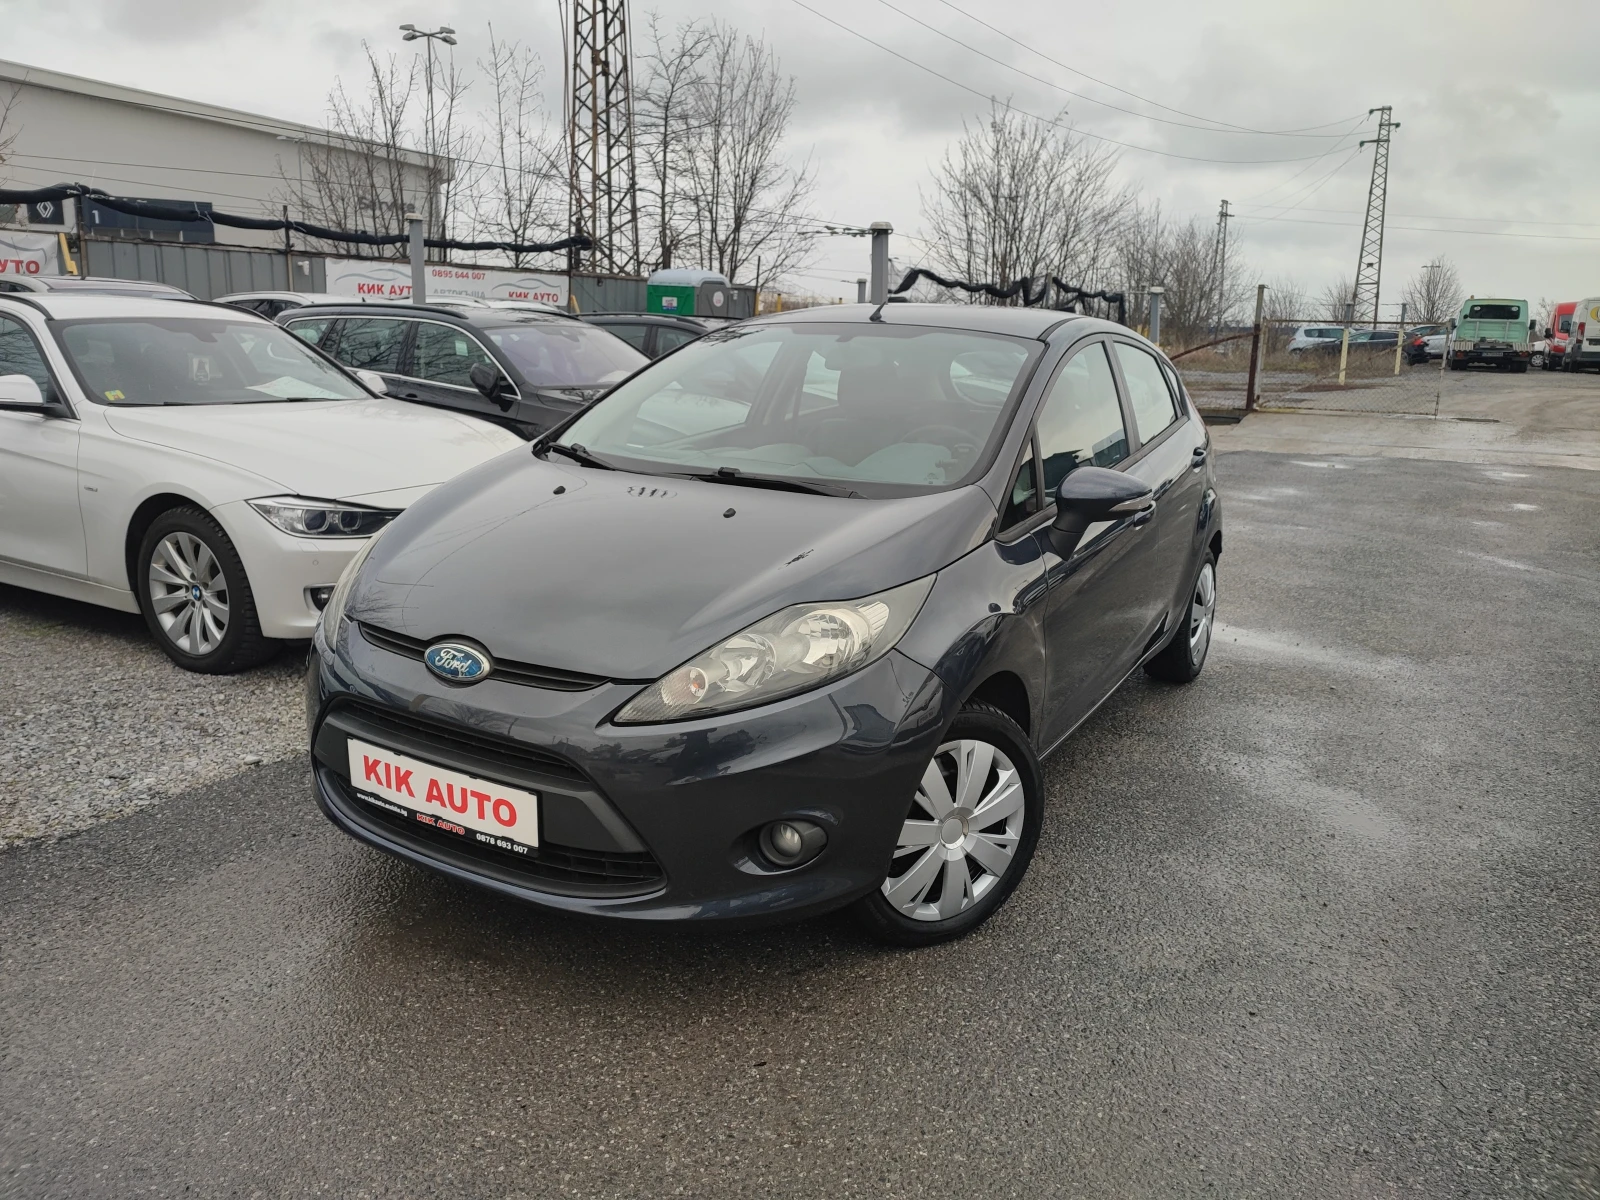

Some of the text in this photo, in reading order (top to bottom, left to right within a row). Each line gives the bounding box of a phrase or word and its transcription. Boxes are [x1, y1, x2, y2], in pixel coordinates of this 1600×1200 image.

[432, 269, 486, 280] 0895 644 007
[389, 284, 412, 296] АУТ
[435, 648, 472, 672] Ford
[363, 754, 518, 827] KIK AUTO
[416, 813, 465, 835] KIK AUTO
[476, 833, 528, 854] 0878 693 007
